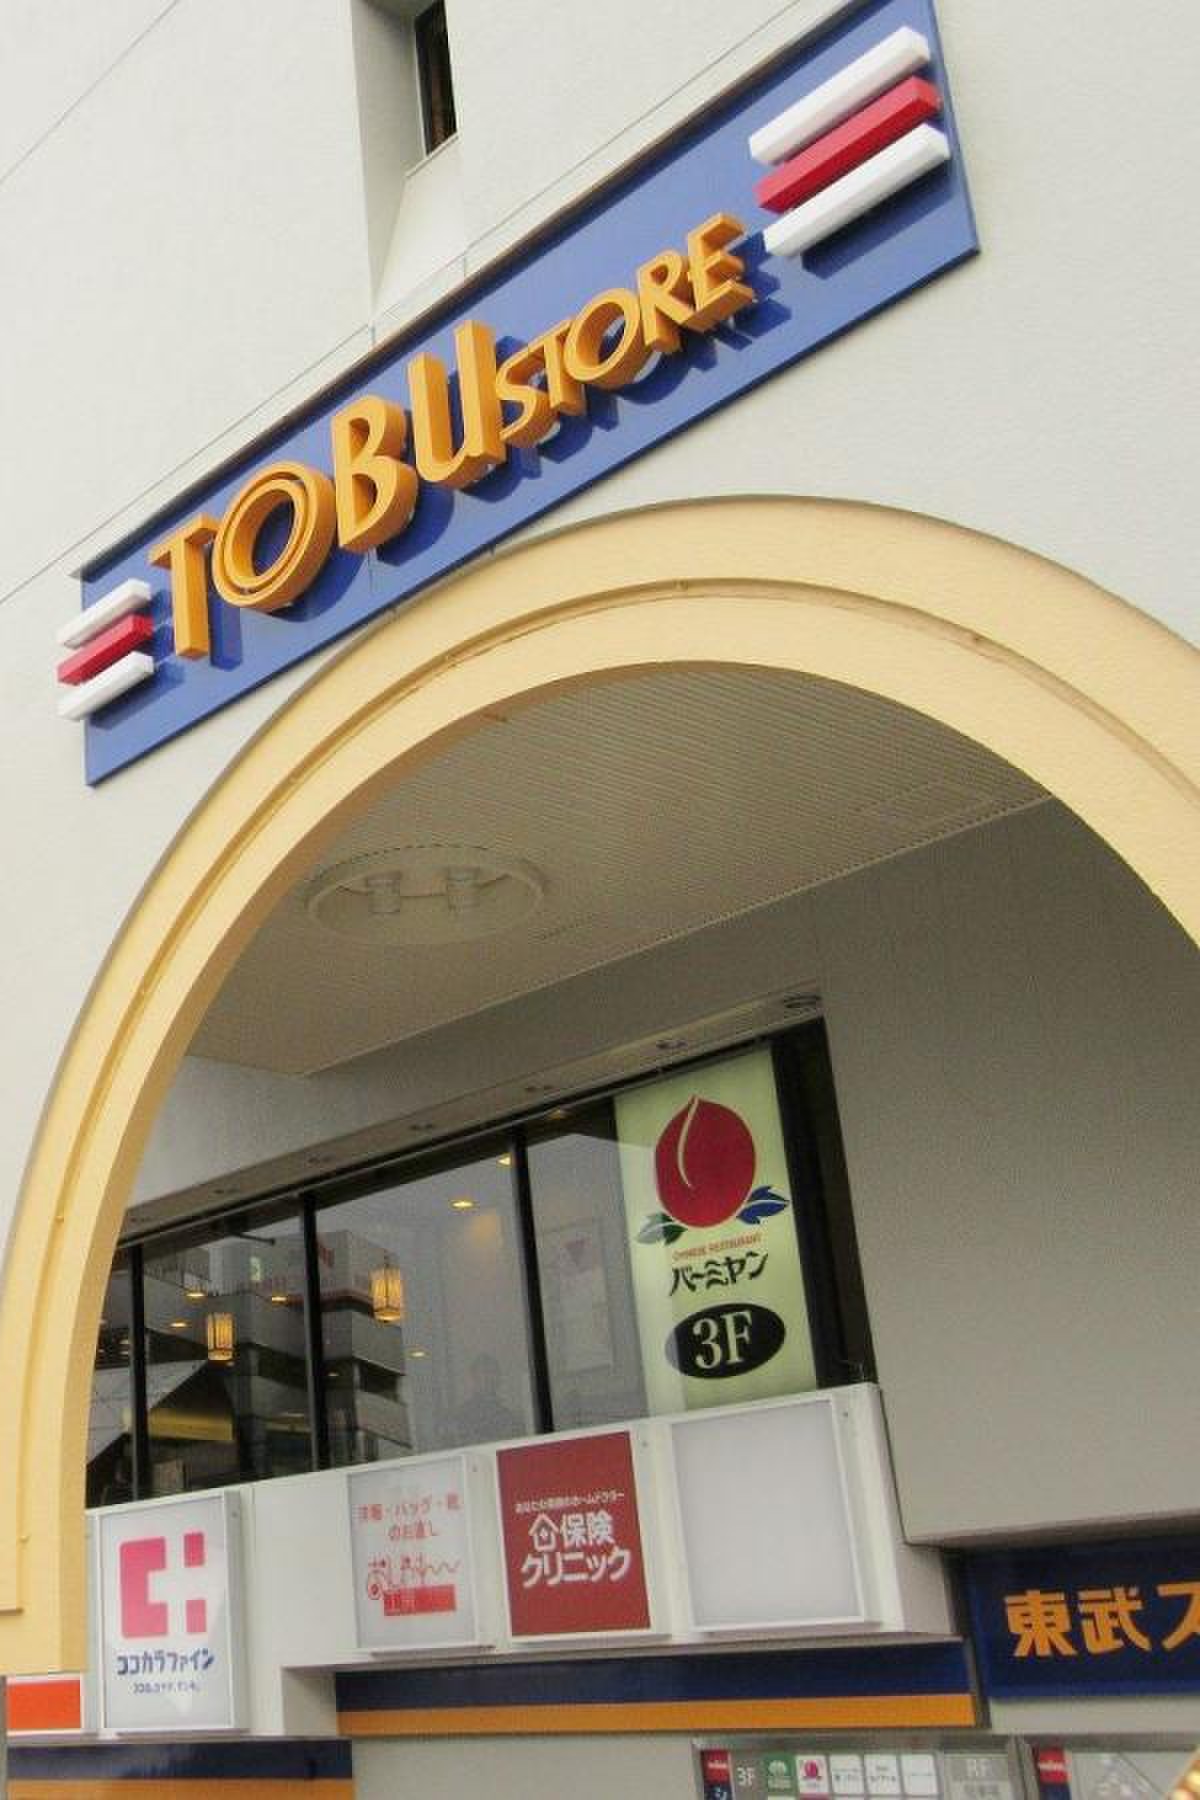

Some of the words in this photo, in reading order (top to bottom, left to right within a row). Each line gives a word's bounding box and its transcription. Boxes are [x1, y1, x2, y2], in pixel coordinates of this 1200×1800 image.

[149, 320, 507, 660] TOBU
[497, 211, 755, 448] STORE
[669, 1251, 768, 1297] バーミヤン
[692, 1310, 753, 1369] 3F
[560, 1509, 616, 1549] 保険
[520, 1545, 630, 1588] クリニック
[117, 1649, 215, 1675] ココカラファイン
